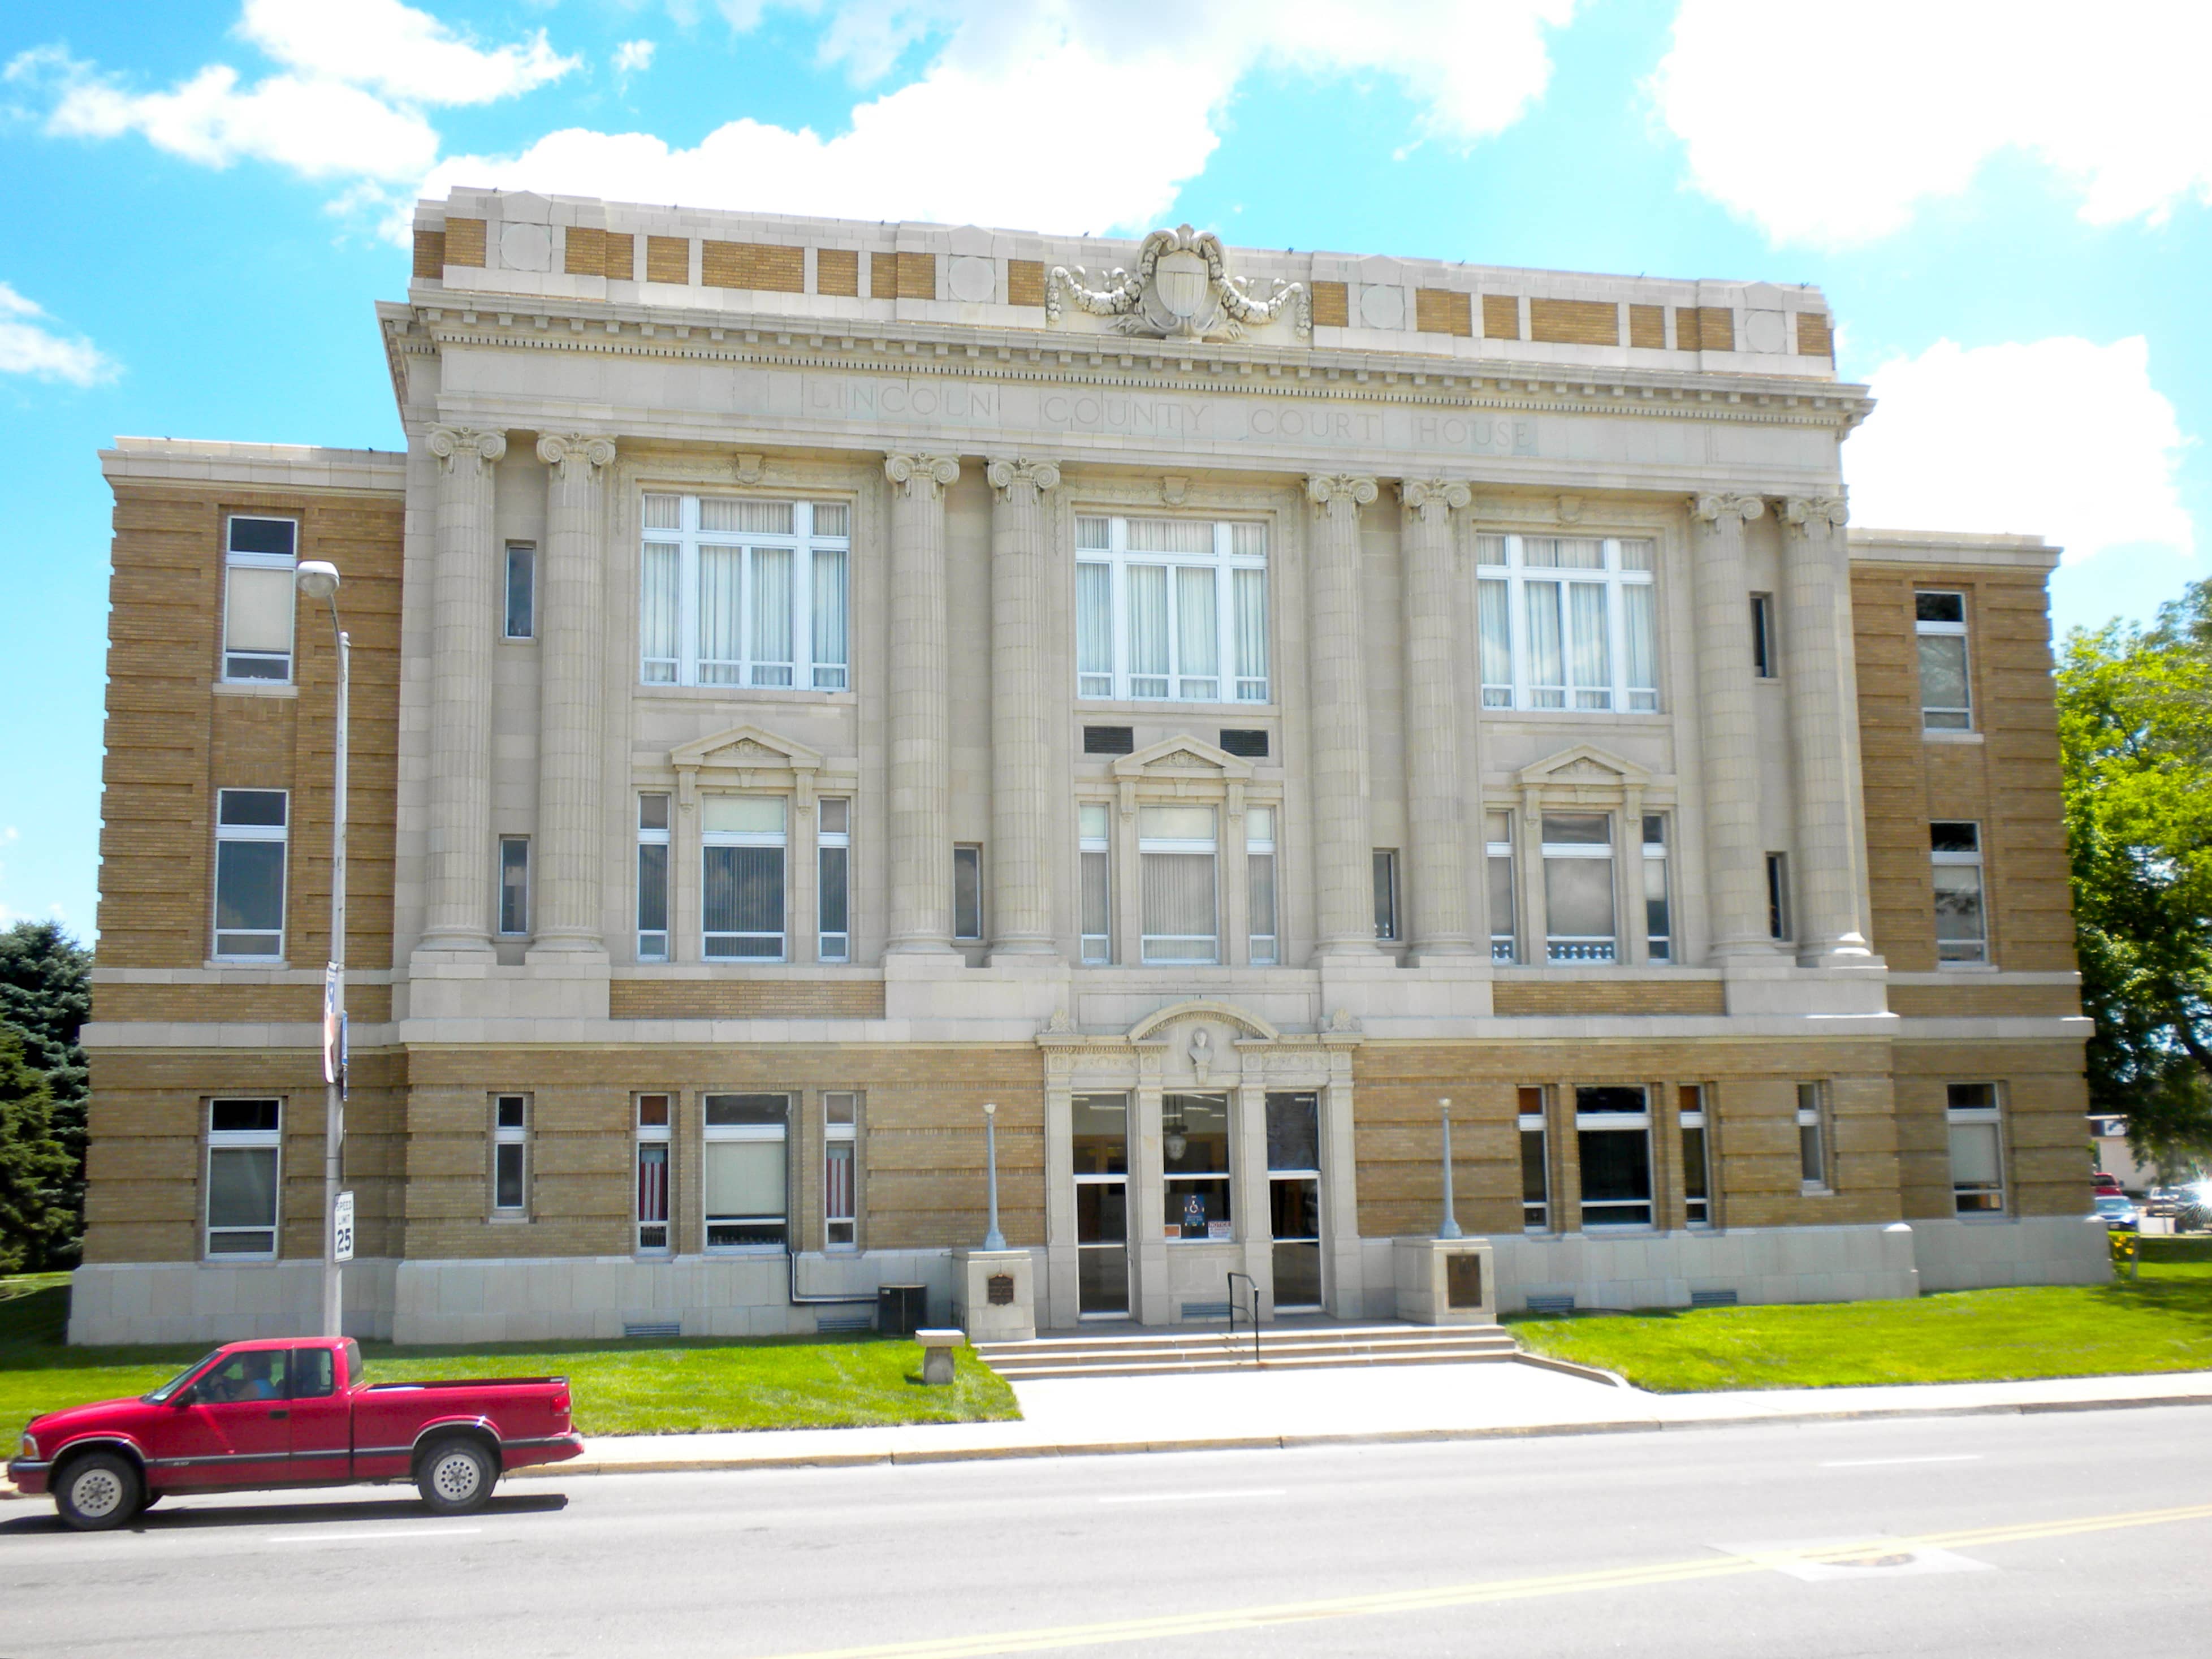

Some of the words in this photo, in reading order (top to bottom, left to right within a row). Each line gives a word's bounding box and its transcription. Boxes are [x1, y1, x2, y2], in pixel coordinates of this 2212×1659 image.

[809, 381, 991, 417] LINCOLN
[1044, 396, 1209, 431] COUNTY
[1251, 408, 1379, 440] COURT
[1415, 417, 1535, 448] HOUSE
[336, 1200, 352, 1212] SPEED
[338, 1213, 351, 1225] LIMIT
[337, 1228, 351, 1253] 25
